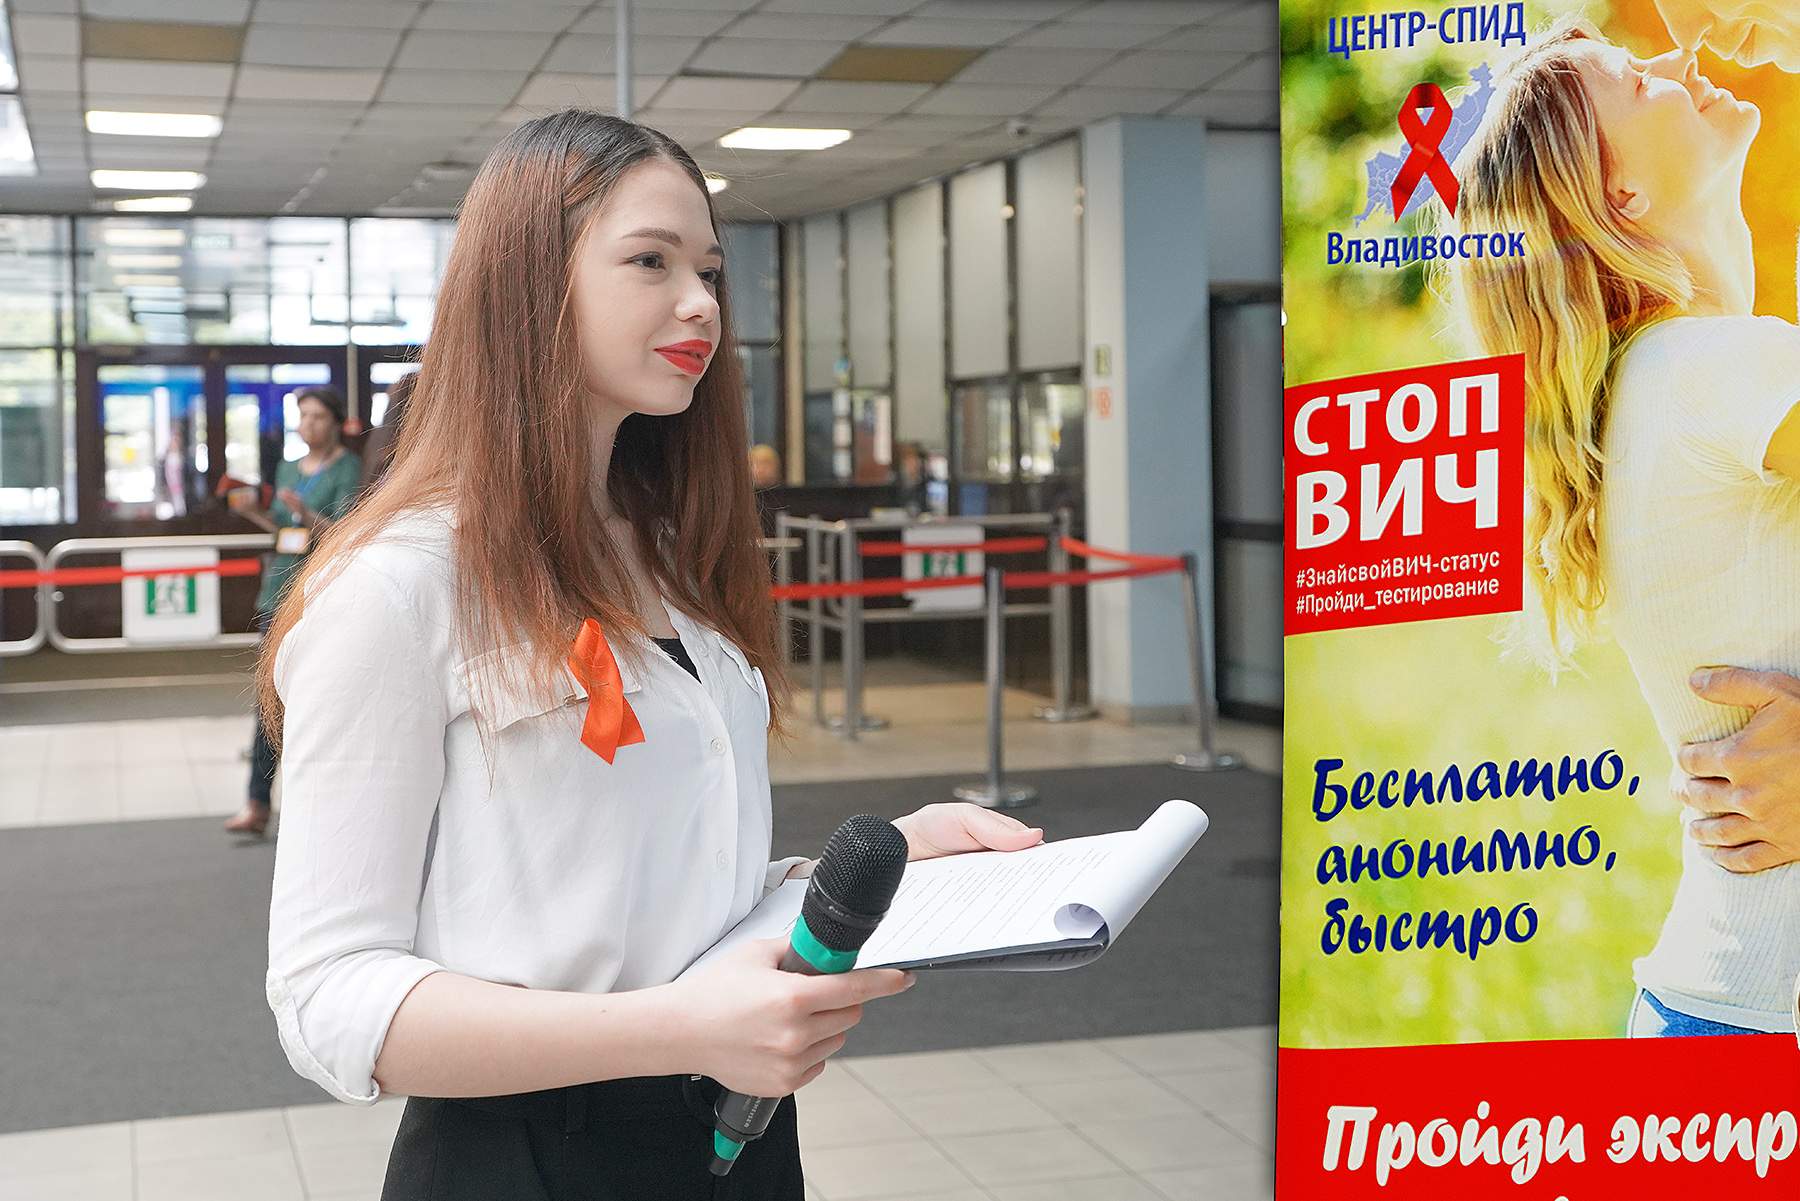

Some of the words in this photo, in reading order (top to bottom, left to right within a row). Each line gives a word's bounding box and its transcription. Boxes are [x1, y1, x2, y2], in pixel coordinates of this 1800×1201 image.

[1328, 2, 1526, 60] ЦЕНТР-СПИД
[1327, 231, 1526, 268] Владивосток
[1293, 373, 1499, 456] СТОП
[1296, 448, 1499, 550] ВИЧ
[1296, 550, 1500, 588] #ЗнайсвойВИЧ-статус
[1296, 578, 1499, 617] #Пройди_тестирование
[1312, 749, 1640, 822] Бесплатно,
[1316, 825, 1617, 885] анонимно,
[1321, 897, 1538, 961] быстро
[1323, 1101, 1586, 1186] Пройди
[1605, 1110, 1798, 1179] экспр
